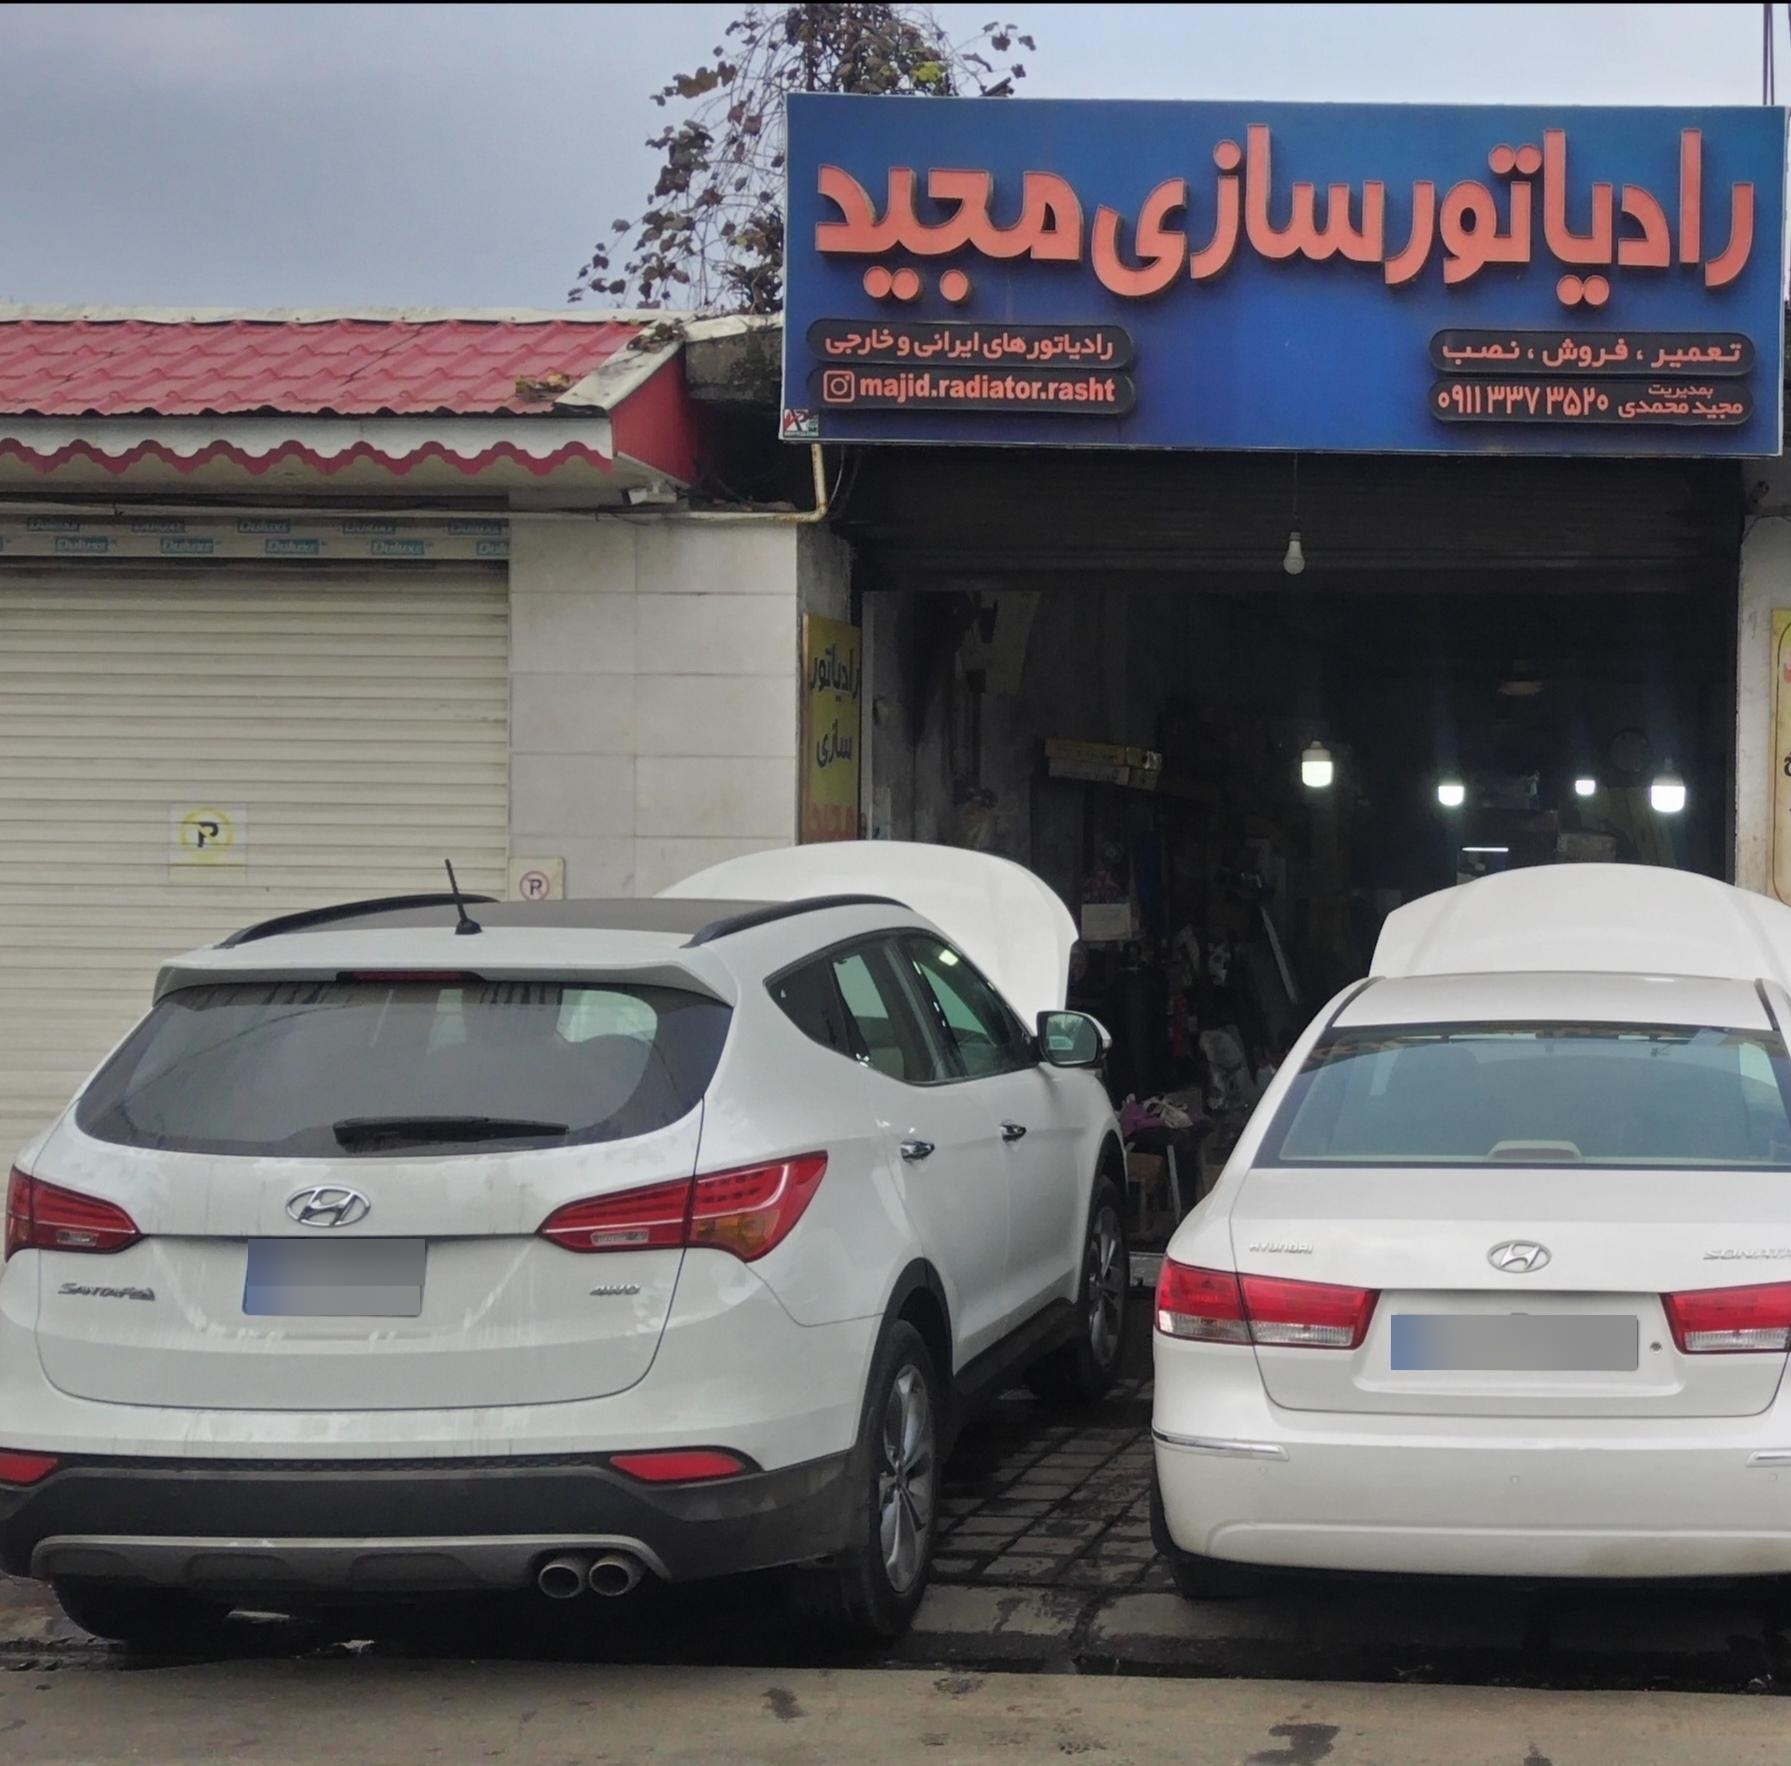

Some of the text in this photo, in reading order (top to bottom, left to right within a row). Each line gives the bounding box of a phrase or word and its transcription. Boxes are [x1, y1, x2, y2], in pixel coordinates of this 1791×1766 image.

[815, 165, 1084, 301] مجید
[825, 329, 894, 354] خارجی
[897, 336, 910, 356] و
[914, 331, 979, 358] ایرانی
[1442, 341, 1521, 365] نصب
[1542, 338, 1628, 367] فروش
[1651, 343, 1742, 368] تعمیر
[859, 373, 1115, 402] majid.radiator.rasht
[1618, 400, 1744, 419] مجید محمدی
